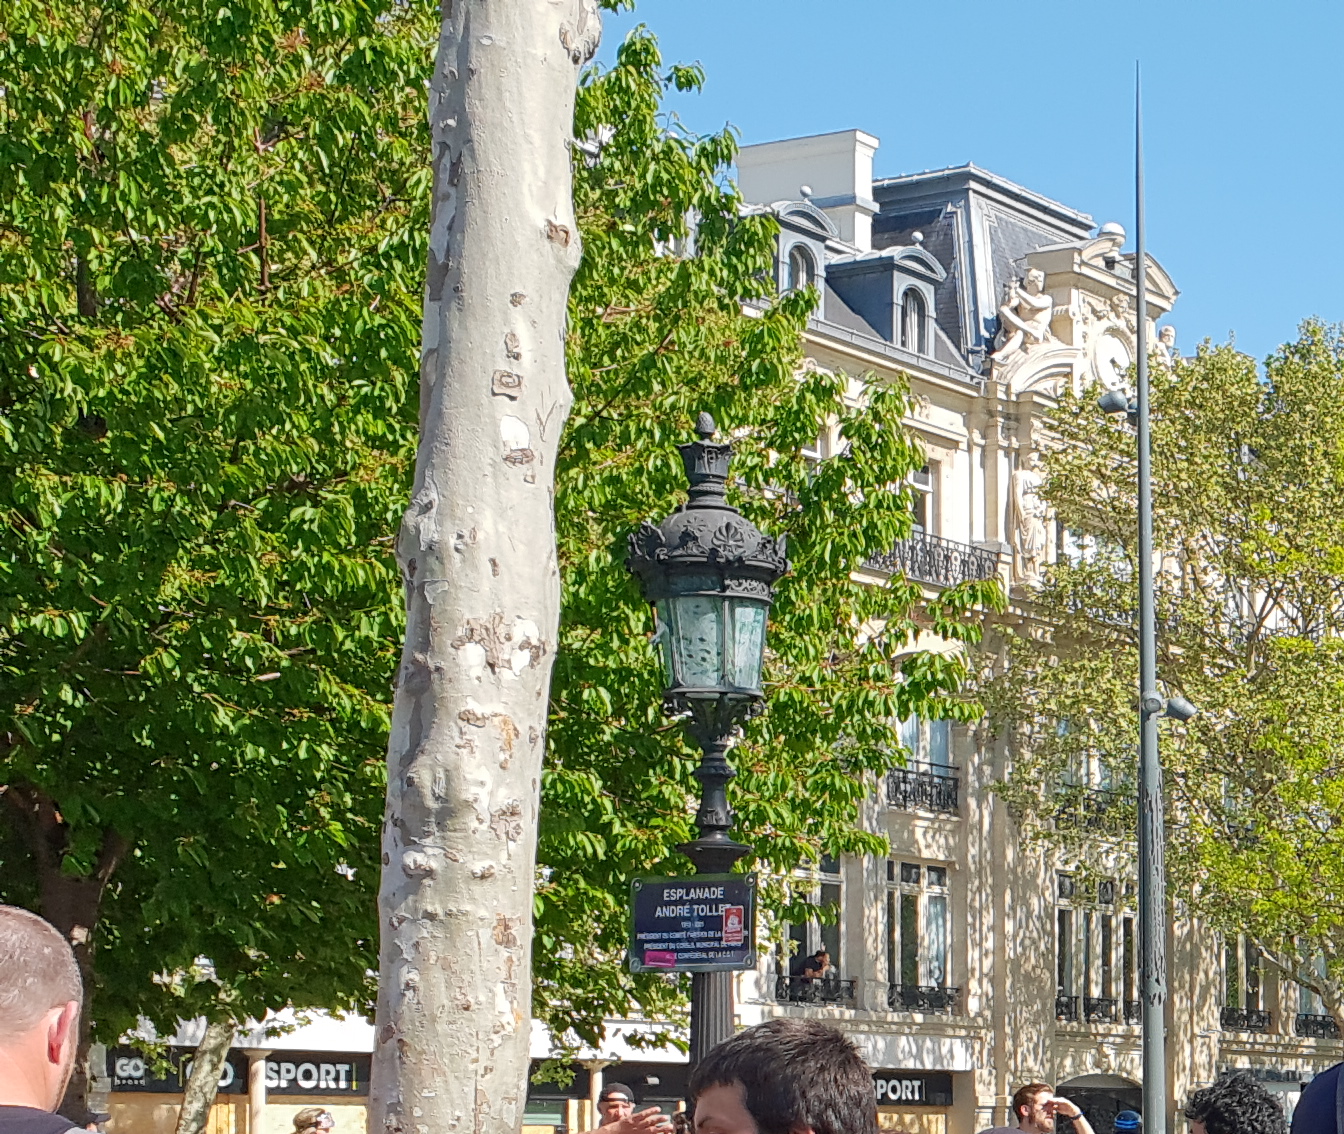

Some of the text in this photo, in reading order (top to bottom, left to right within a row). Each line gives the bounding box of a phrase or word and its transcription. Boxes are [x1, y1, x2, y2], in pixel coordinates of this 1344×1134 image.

[663, 886, 724, 901] ESPLANADE
[655, 902, 690, 918] ANDRÉ
[116, 1057, 145, 1078] GO
[265, 1062, 350, 1089] SPORT
[874, 1079, 921, 1100] PORT
